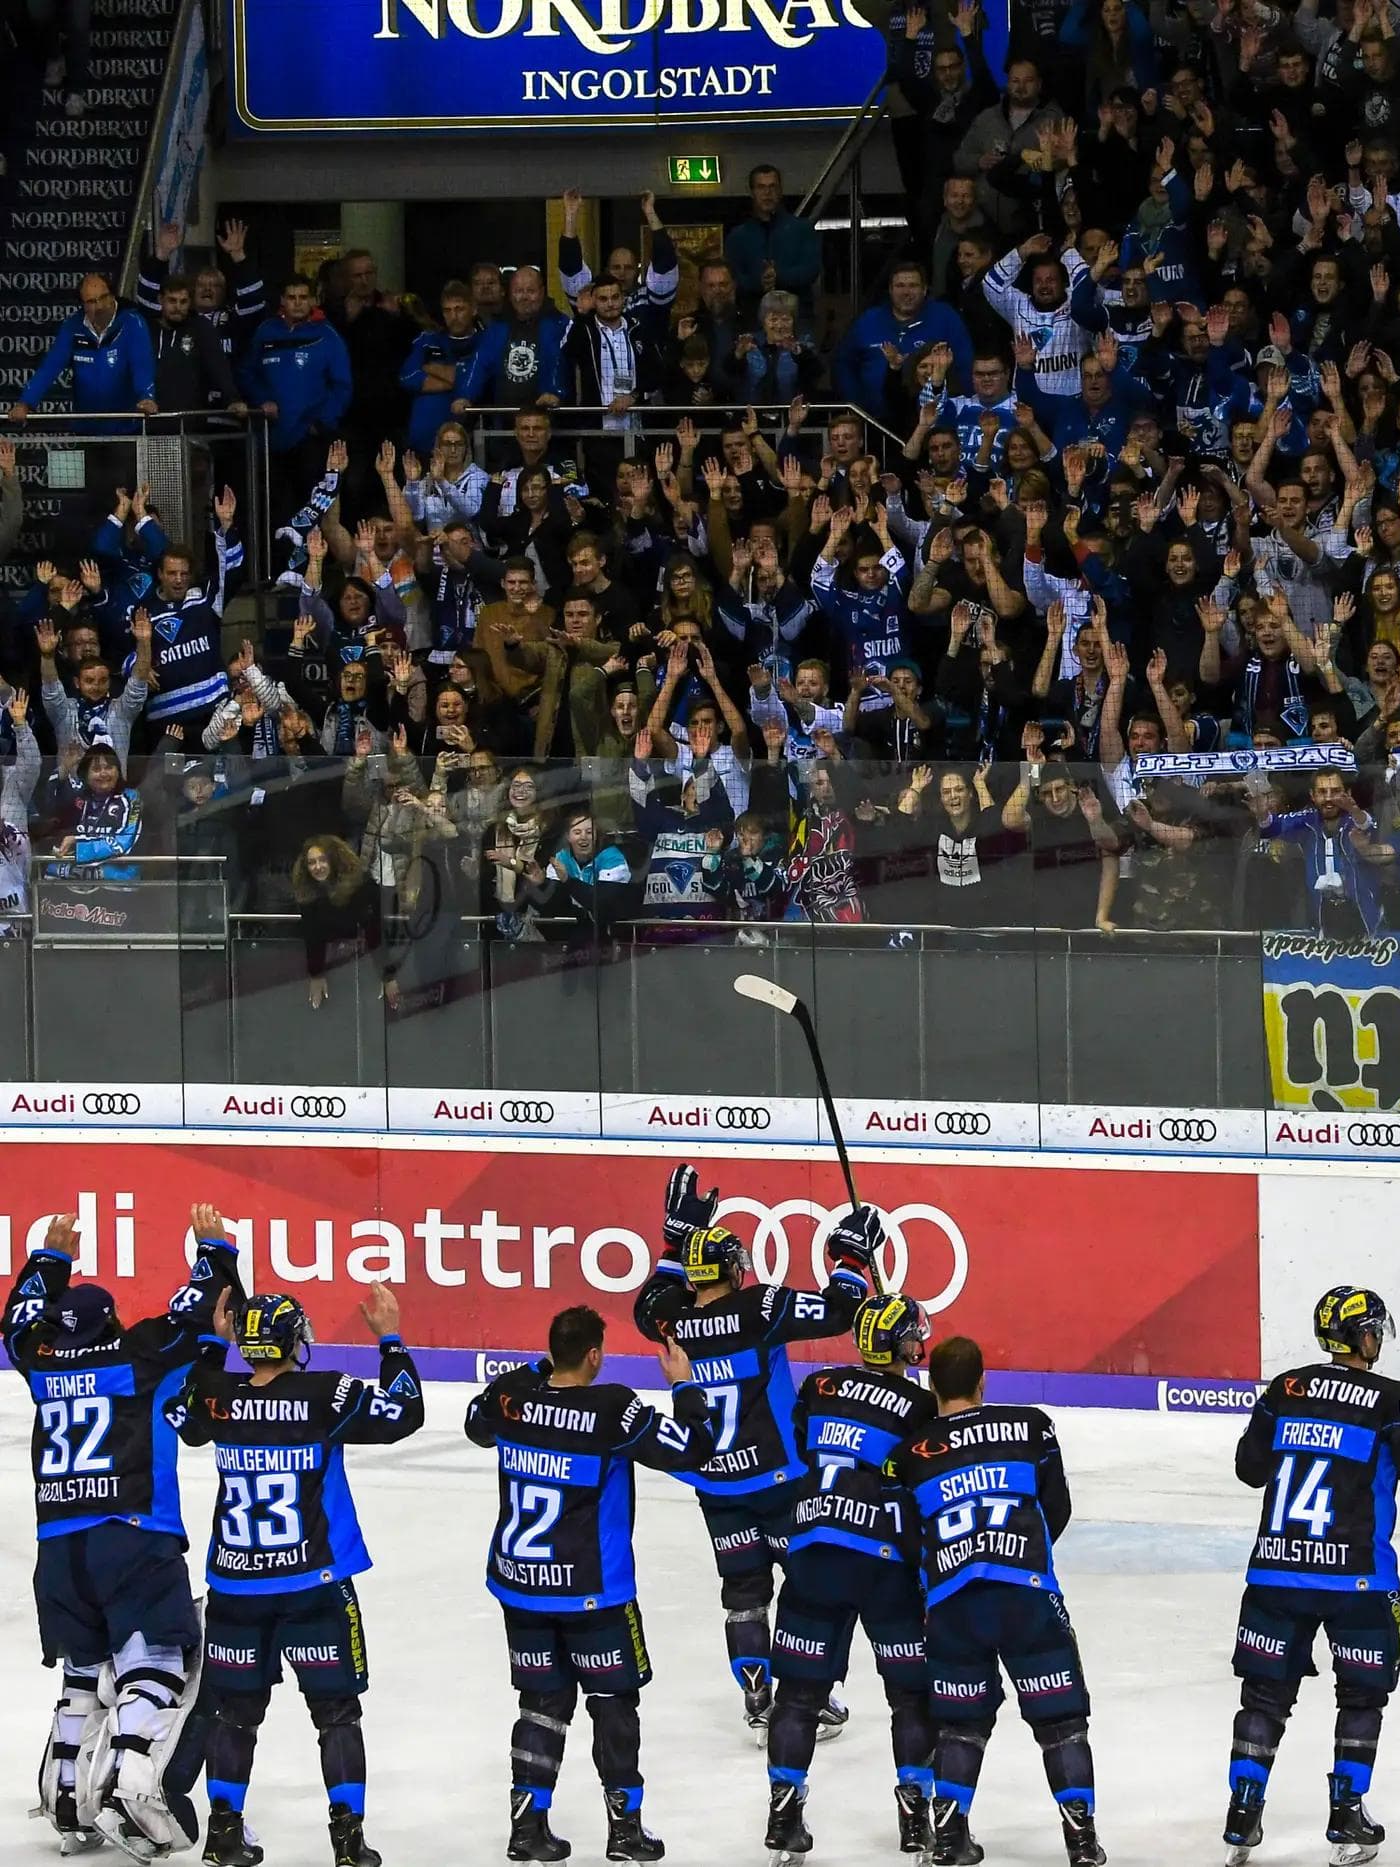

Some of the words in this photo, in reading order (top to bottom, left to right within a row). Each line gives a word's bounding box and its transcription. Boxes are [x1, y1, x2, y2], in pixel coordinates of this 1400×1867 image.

[522, 64, 777, 100] INGOLSTADT
[35, 120, 149, 139] NORDBRÄU
[26, 148, 140, 168] NORDBRÄU
[18, 179, 134, 200] NORDBRÄU
[11, 211, 128, 231] NORDBRÄU
[6, 240, 121, 261] NORDBRÄU
[160, 635, 210, 665] SATURN
[15, 1095, 74, 1112] Audi
[225, 1098, 282, 1114] Audi
[436, 1101, 491, 1119] Audi
[651, 1107, 707, 1125] Audi
[868, 1113, 926, 1130] Audi
[1091, 1120, 1150, 1136] Audi
[1278, 1124, 1339, 1142] Audi
[185, 1208, 649, 1297] quattro
[675, 1315, 740, 1340] SATURN
[691, 1359, 734, 1384] LIVAN
[46, 1373, 96, 1398] REIMER
[1167, 1386, 1256, 1408] covestro
[1307, 1377, 1381, 1409] SATURN
[231, 1399, 309, 1422] SATURN
[837, 1380, 914, 1417] SATURN
[522, 1402, 597, 1432] SATURN
[40, 1398, 113, 1475] 32
[818, 1421, 867, 1451] JOBKE
[949, 1421, 1030, 1449] SATURN
[1281, 1422, 1343, 1450] FRIESEN
[502, 1446, 571, 1480] CANNONE
[940, 1467, 1010, 1502] SCHÜTZ
[1268, 1454, 1334, 1540] 14
[219, 1472, 302, 1548] 33
[500, 1481, 563, 1560] 12
[714, 1526, 761, 1553] CINQUE
[208, 1642, 256, 1665] CINQUE
[774, 1627, 826, 1658] CINQUE
[873, 1640, 926, 1662] CINQUE
[1237, 1626, 1287, 1656] CINQUE
[285, 1644, 340, 1664] CINQUE
[571, 1649, 623, 1669] CINQUE
[1330, 1642, 1383, 1667] CINQUE
[933, 1678, 987, 1700] CINQUE
[1016, 1670, 1073, 1696] CINQUE
